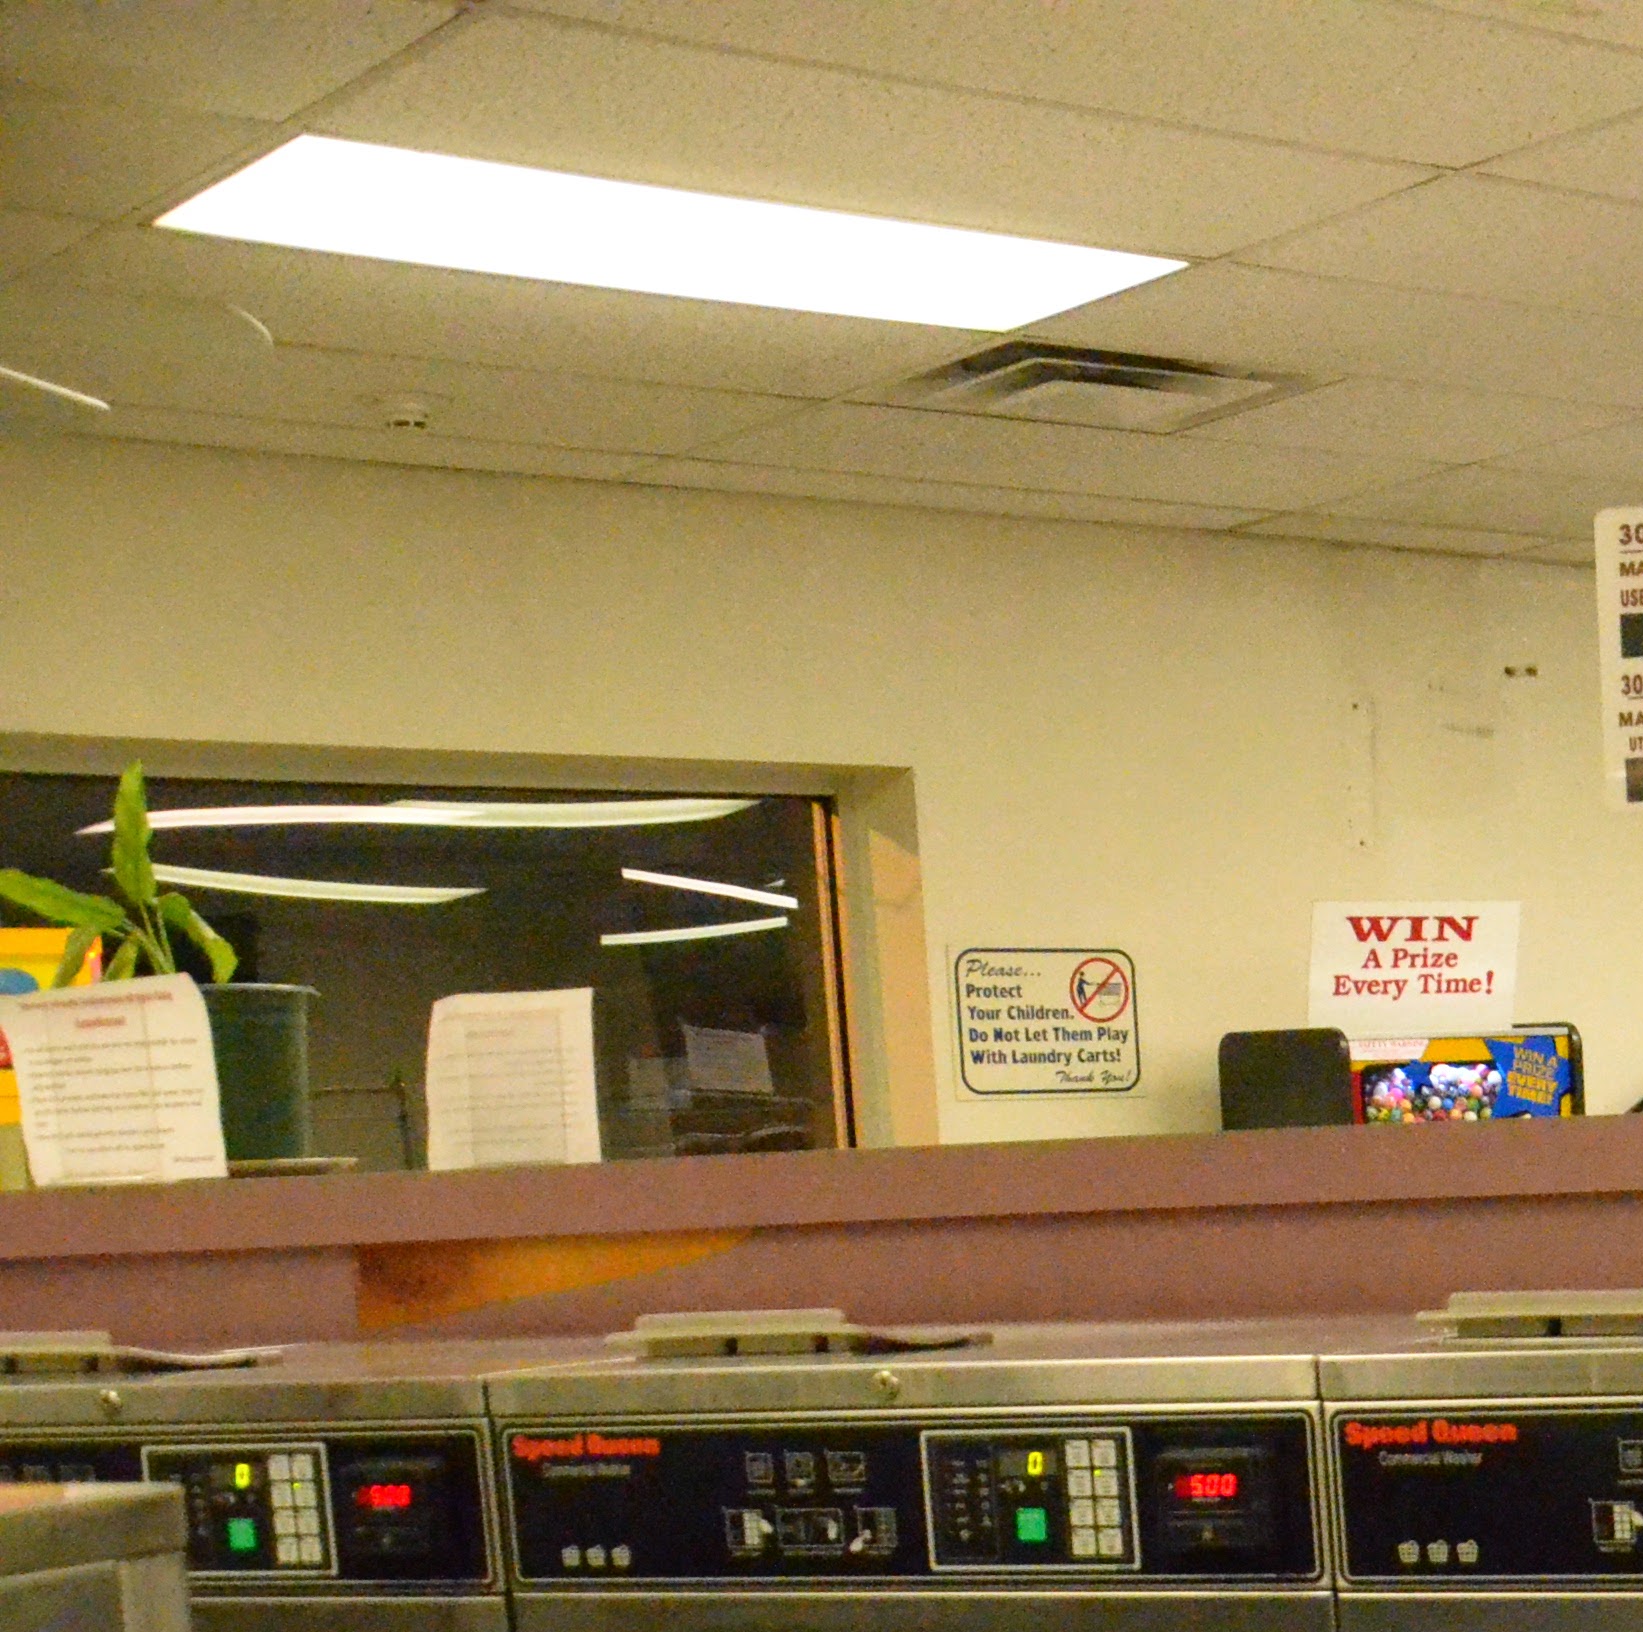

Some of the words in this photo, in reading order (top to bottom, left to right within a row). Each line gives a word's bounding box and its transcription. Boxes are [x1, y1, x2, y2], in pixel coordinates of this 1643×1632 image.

[1621, 674, 1643, 695] 30
[1346, 916, 1479, 942] WIN
[1362, 949, 1382, 969] A
[1391, 947, 1458, 968] Prize
[965, 959, 1041, 978] Please...
[965, 984, 1023, 998] Protect
[1333, 974, 1408, 1001] Every
[1418, 970, 1494, 995] Time!
[968, 1006, 1001, 1020] Your
[1007, 1005, 1075, 1020] Children.
[968, 1028, 989, 1042] Do
[993, 1028, 1020, 1042] Not
[1025, 1027, 1048, 1041] Let
[1052, 1026, 1093, 1041] Them
[1097, 1026, 1128, 1043] Play
[970, 1049, 1007, 1064] With
[1012, 1048, 1072, 1066] Laundry
[1077, 1047, 1121, 1063] Carts!
[1514, 1047, 1545, 1064] WIN
[1055, 1070, 1095, 1083] Thank
[1507, 1070, 1558, 1091] EVERY
[1027, 1451, 1044, 1476] 0
